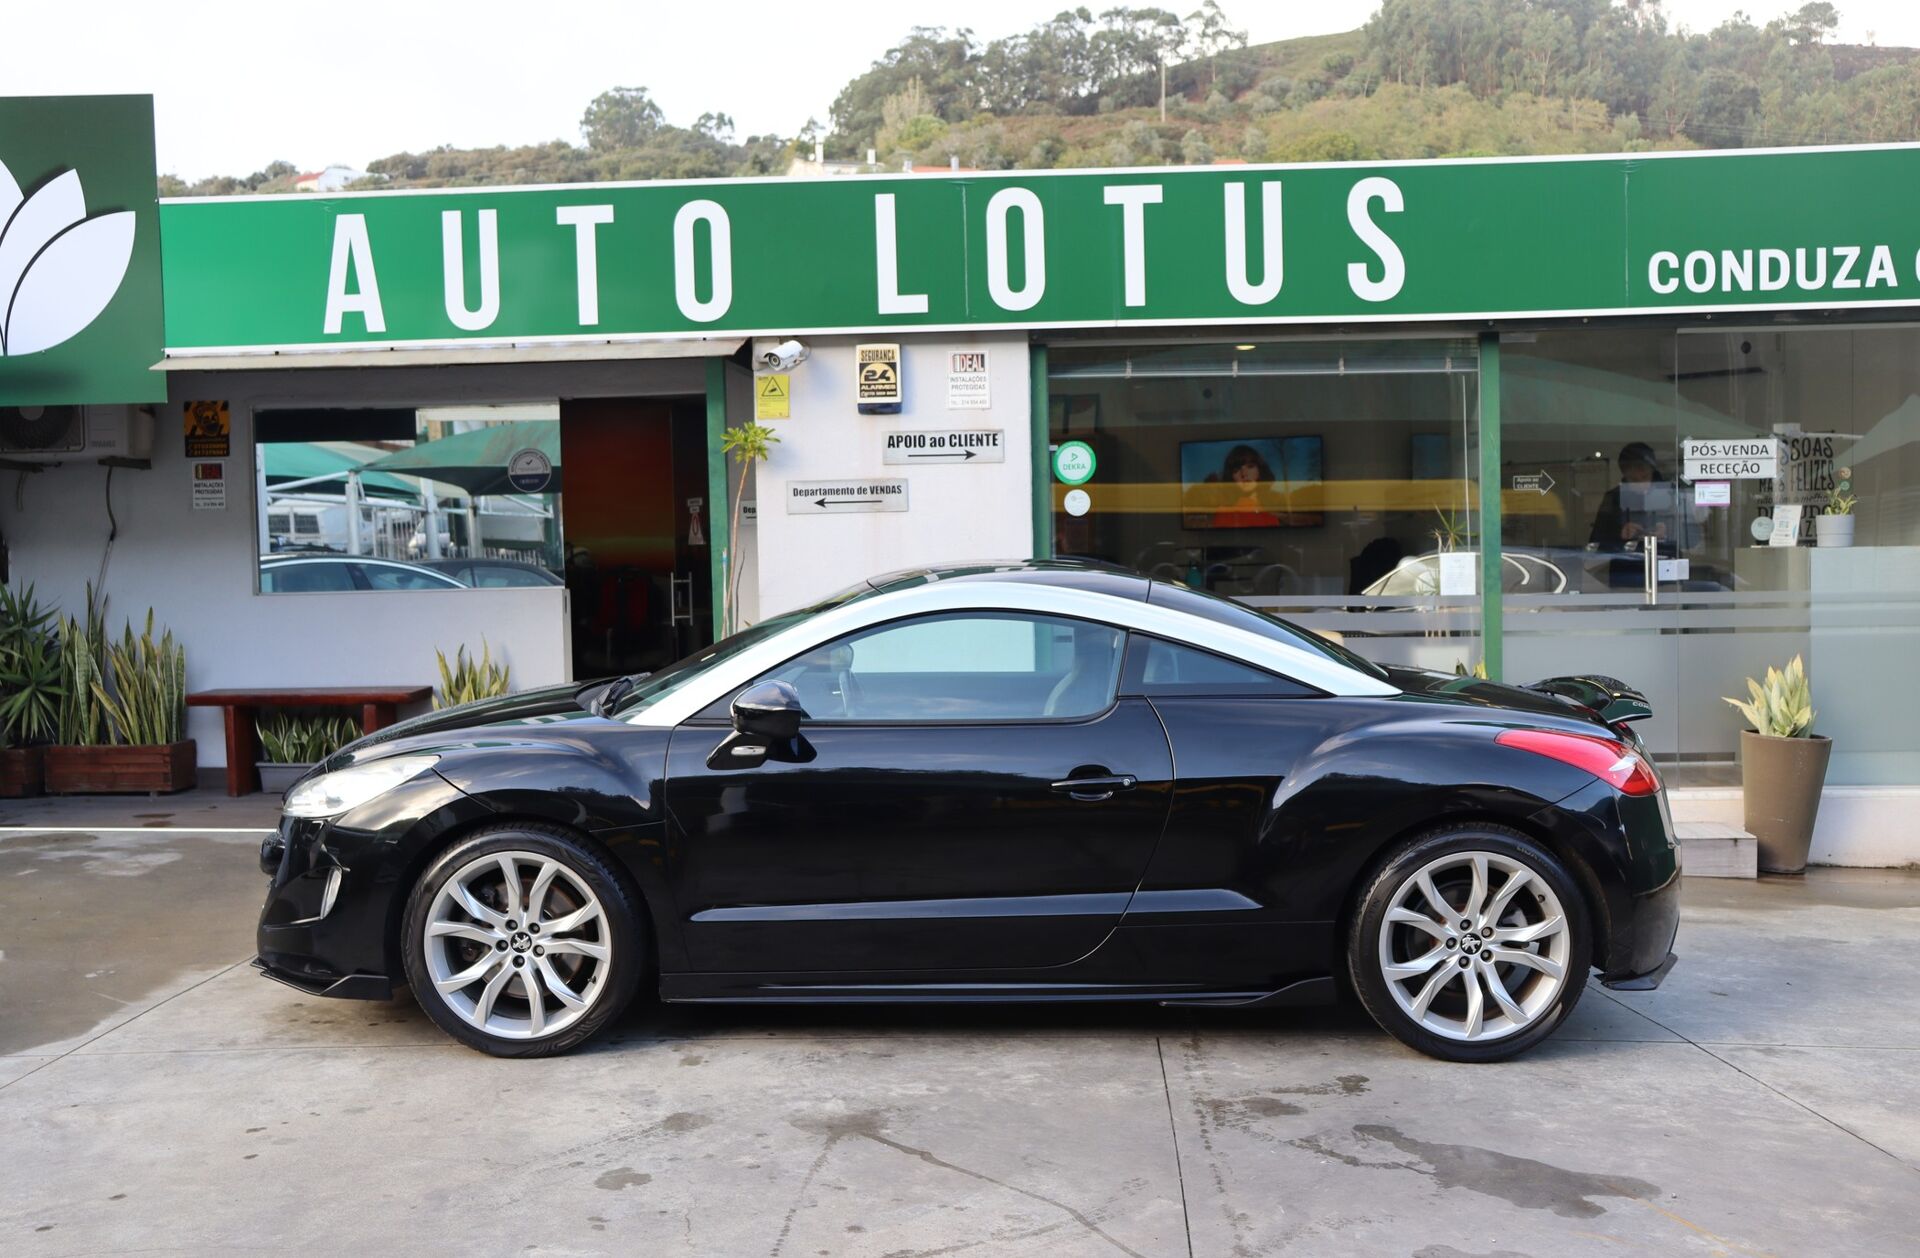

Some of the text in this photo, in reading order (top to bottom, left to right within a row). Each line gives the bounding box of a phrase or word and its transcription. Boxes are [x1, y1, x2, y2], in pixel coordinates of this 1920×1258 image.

[323, 176, 1406, 335] AUTO LOTUS
[1648, 245, 1898, 293] CONDUZA
[864, 369, 891, 382] 24
[887, 433, 998, 449] APOIO ao CLIENTE
[1691, 442, 1769, 457] PÓS-VENDA
[1062, 463, 1087, 471] DEKRA
[1700, 460, 1761, 477] RECEÇÃO
[1790, 459, 1835, 492] FELIZES
[793, 484, 902, 497] Departamento de VENDAS
